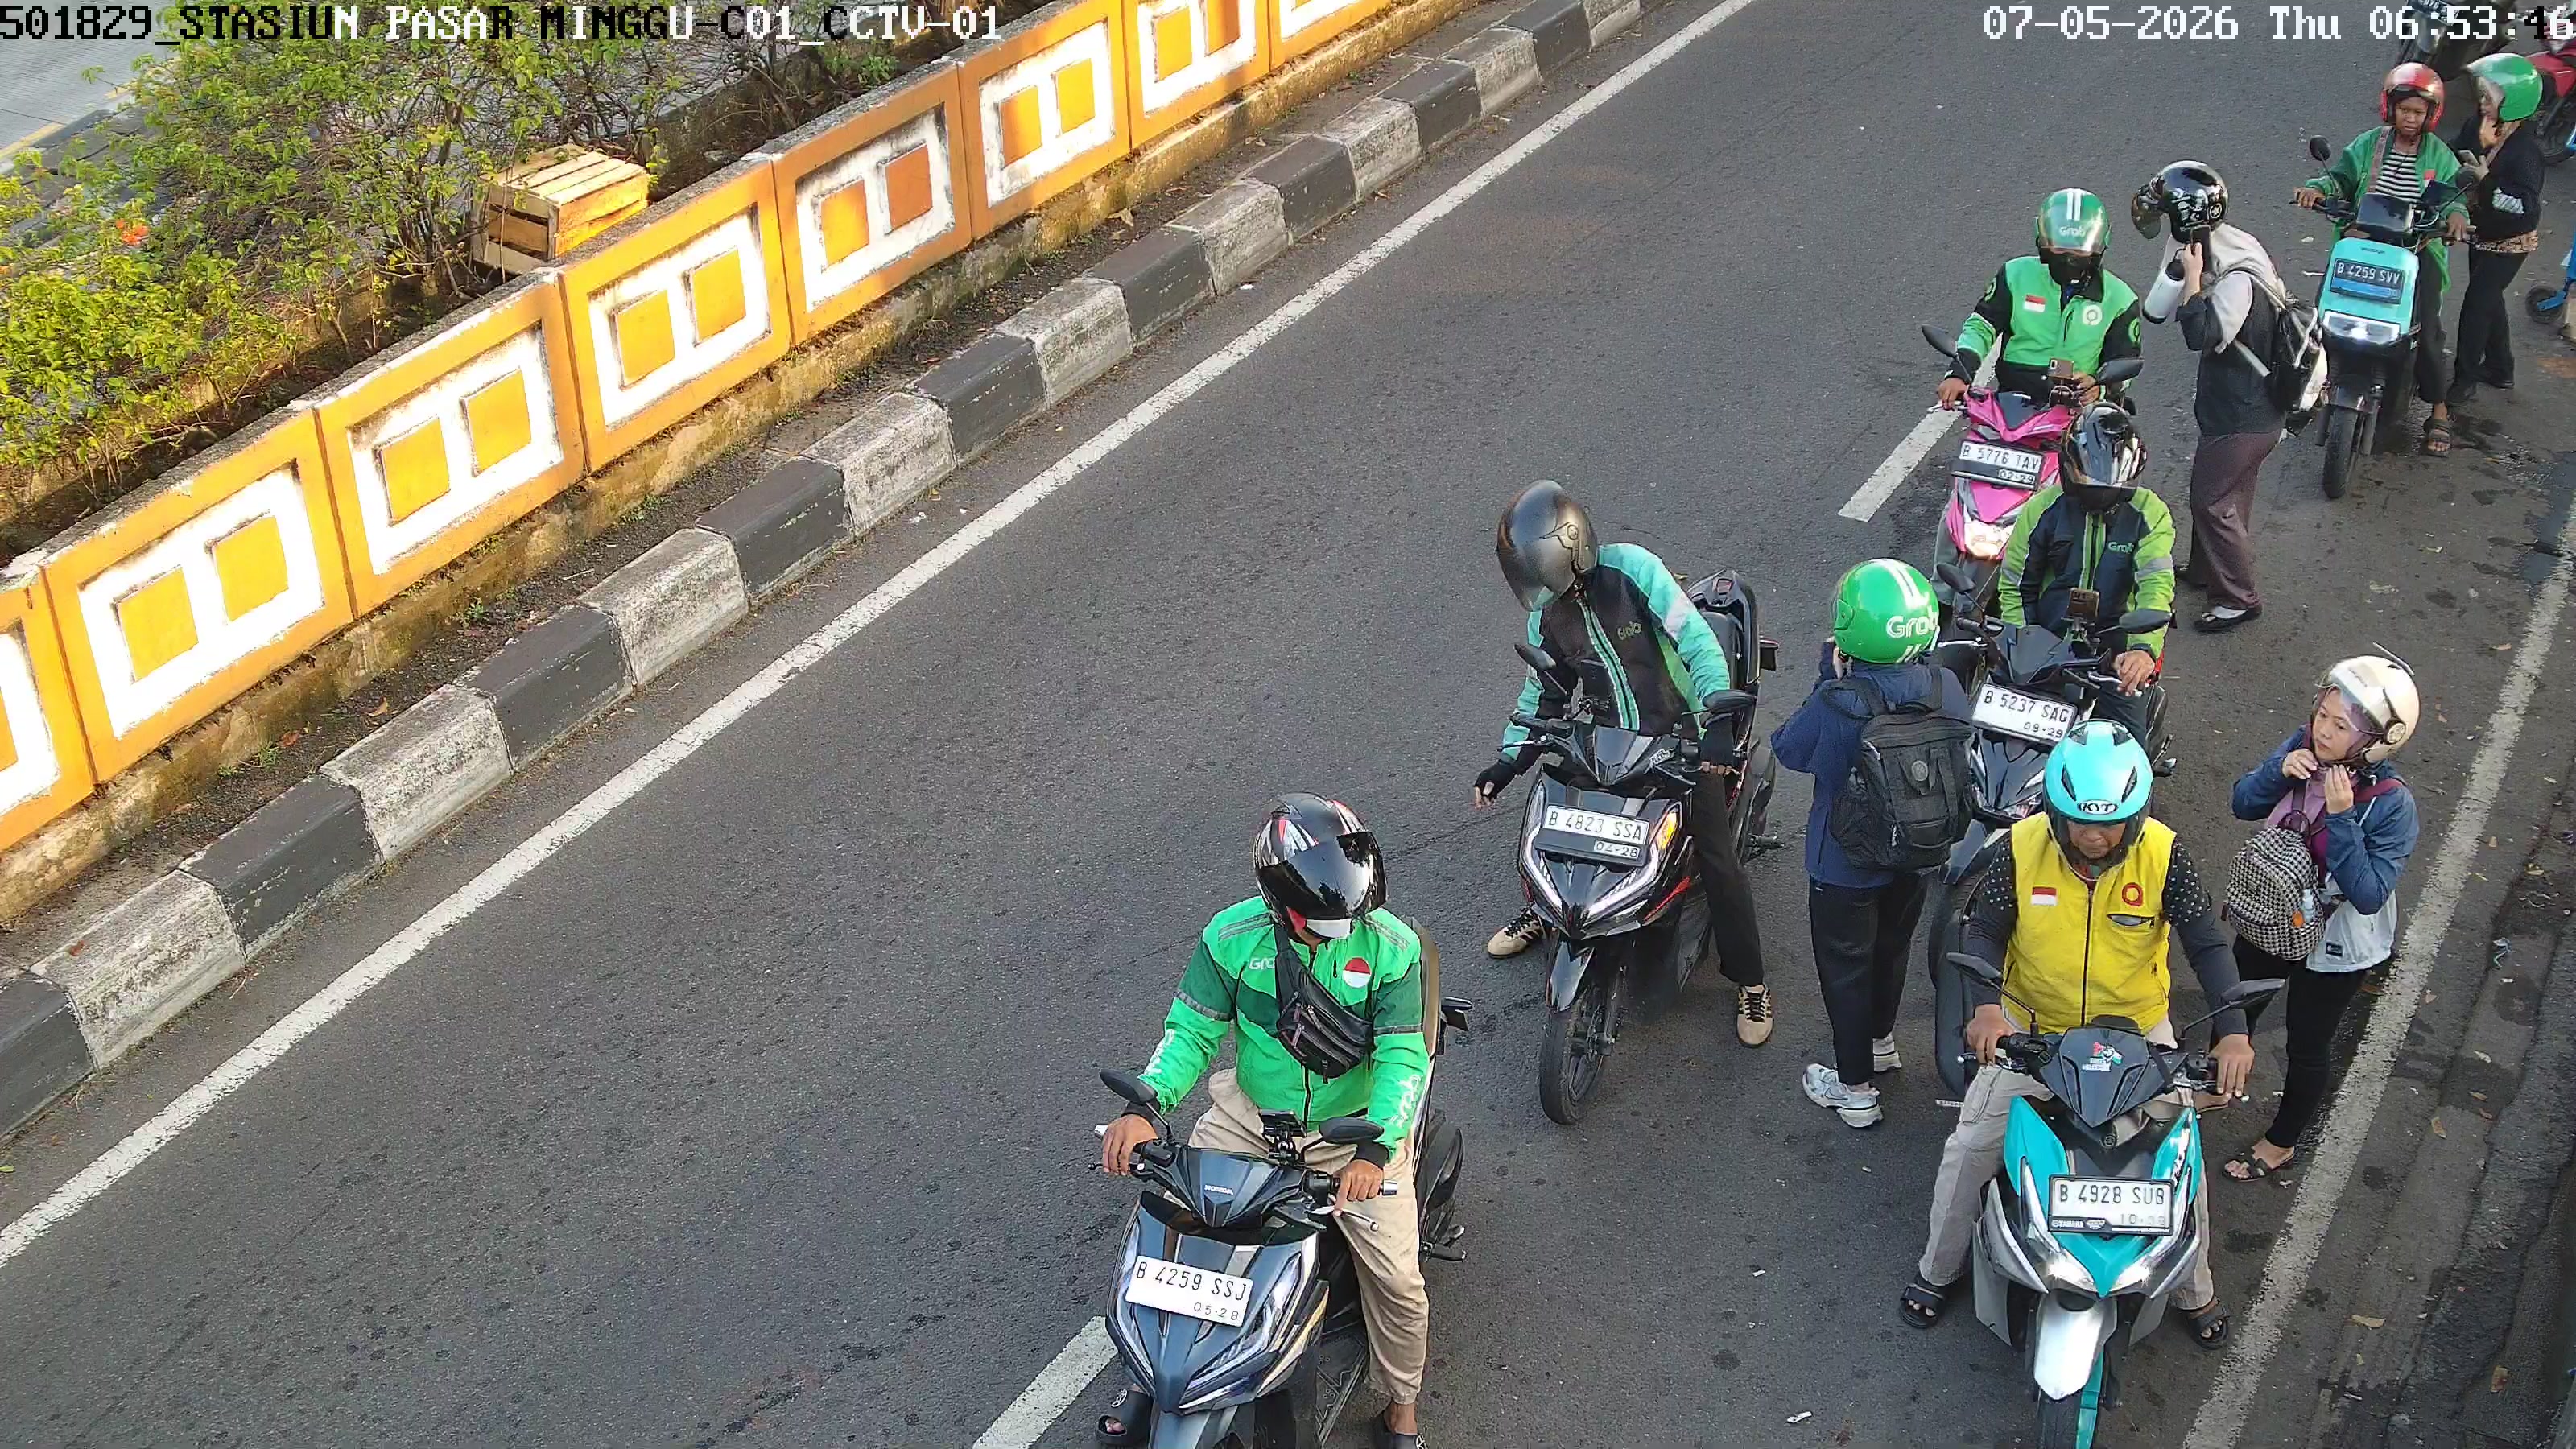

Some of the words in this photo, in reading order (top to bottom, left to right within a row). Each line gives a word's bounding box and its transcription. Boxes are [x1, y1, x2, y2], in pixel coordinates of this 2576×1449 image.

[2337, 262, 2345, 275] B
[1963, 444, 1971, 457] B
[1977, 447, 2010, 464] 5776
[1984, 690, 1994, 704] B
[2000, 693, 2036, 714] 5237
[2041, 704, 2070, 723] SAG
[1549, 811, 1559, 826] B
[1565, 814, 1604, 833] 4823
[1612, 820, 1642, 840] SSA
[1249, 958, 1276, 970] Gra
[2060, 1184, 2068, 1203] B
[2078, 1184, 2122, 1204] 4928
[1136, 1261, 1147, 1279] B
[1154, 1266, 1203, 1291] 4259
[1212, 1278, 1246, 1301] SSJ
